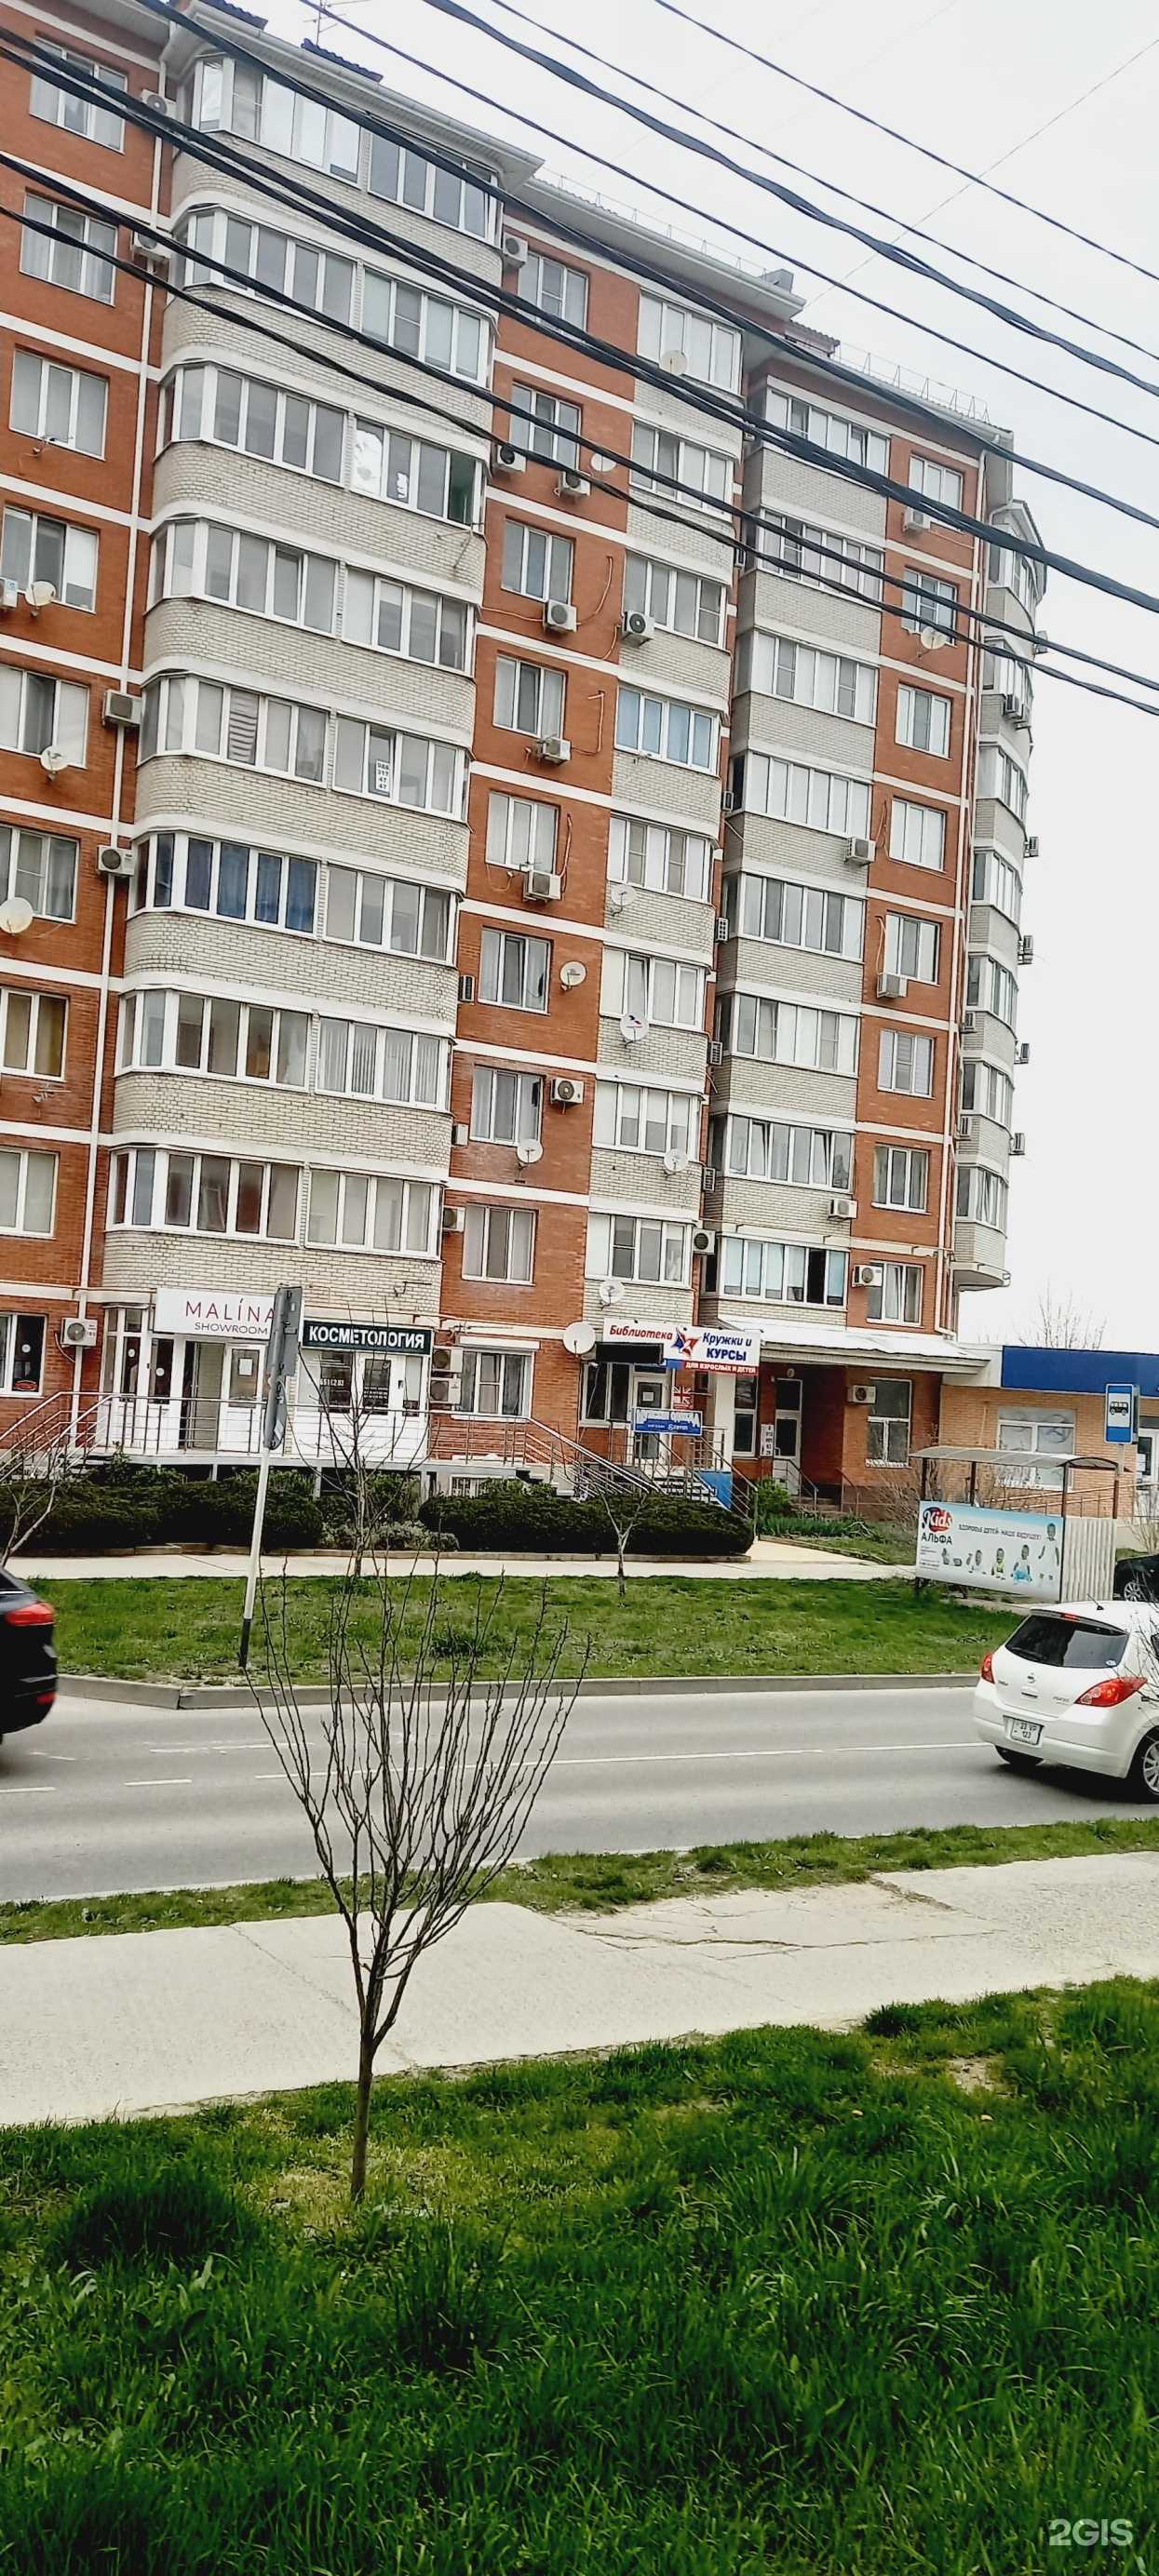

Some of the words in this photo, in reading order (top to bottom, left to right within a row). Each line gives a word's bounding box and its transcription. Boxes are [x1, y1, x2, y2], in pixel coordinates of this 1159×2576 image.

[195, 1322, 268, 1335] SHOWROOM
[610, 1325, 673, 1340] Библиотека
[309, 1325, 425, 1348] КОСМЕТОЛОГИЯ
[703, 1333, 743, 1347] Кружки
[745, 1338, 752, 1347] и
[707, 1348, 747, 1362] КУРСЫ
[685, 1362, 699, 1370] ДЛЯ
[699, 1362, 732, 1372] ВЗРОСЛЫХ
[923, 1509, 953, 1529] Kids
[921, 1533, 953, 1545] АЛЬФА
